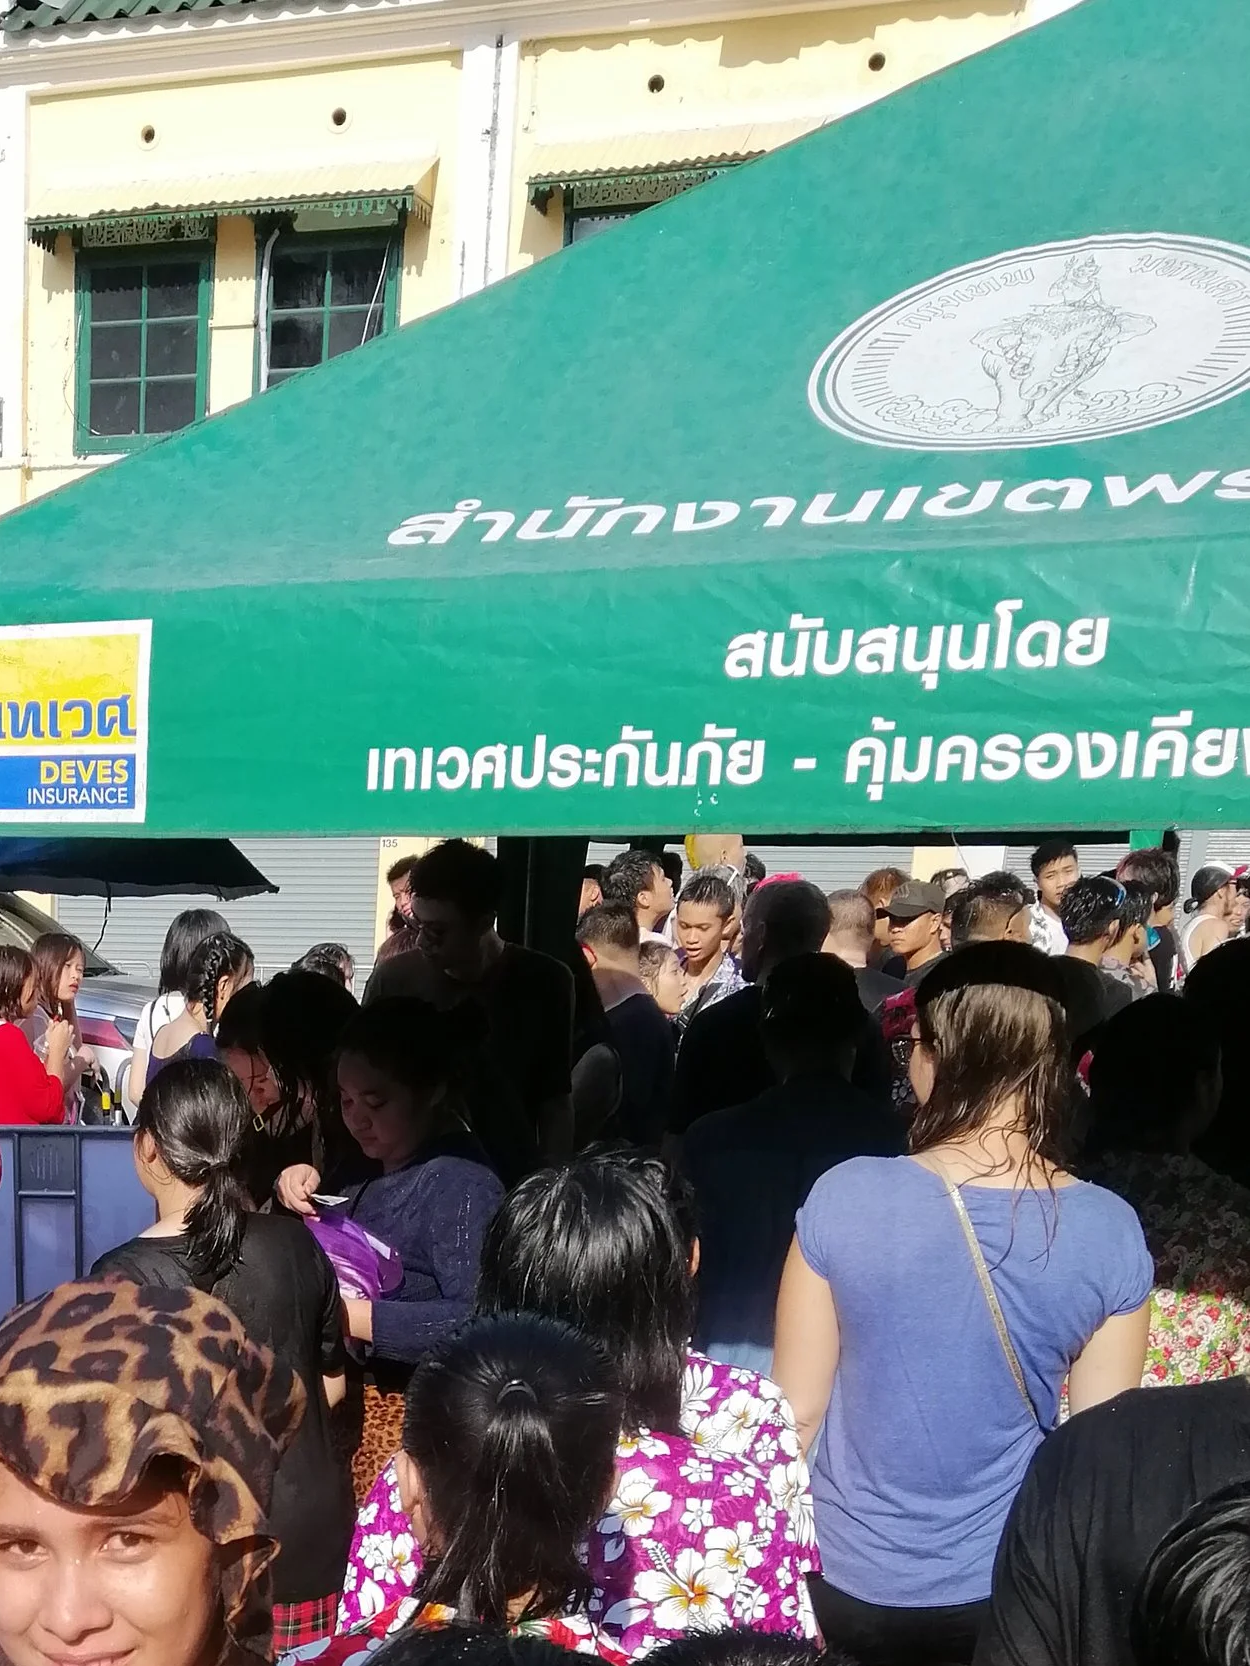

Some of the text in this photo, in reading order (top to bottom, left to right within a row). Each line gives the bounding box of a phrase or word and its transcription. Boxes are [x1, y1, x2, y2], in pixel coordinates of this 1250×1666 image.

[724, 599, 1110, 691] สนับสนุนโดย
[366, 723, 766, 792] เทเวศประกันภัย
[845, 710, 1250, 802] คุ้มครองเคีย
[40, 759, 129, 785] DEVES
[27, 787, 129, 805] INSURANCE
[381, 838, 398, 848] 135
